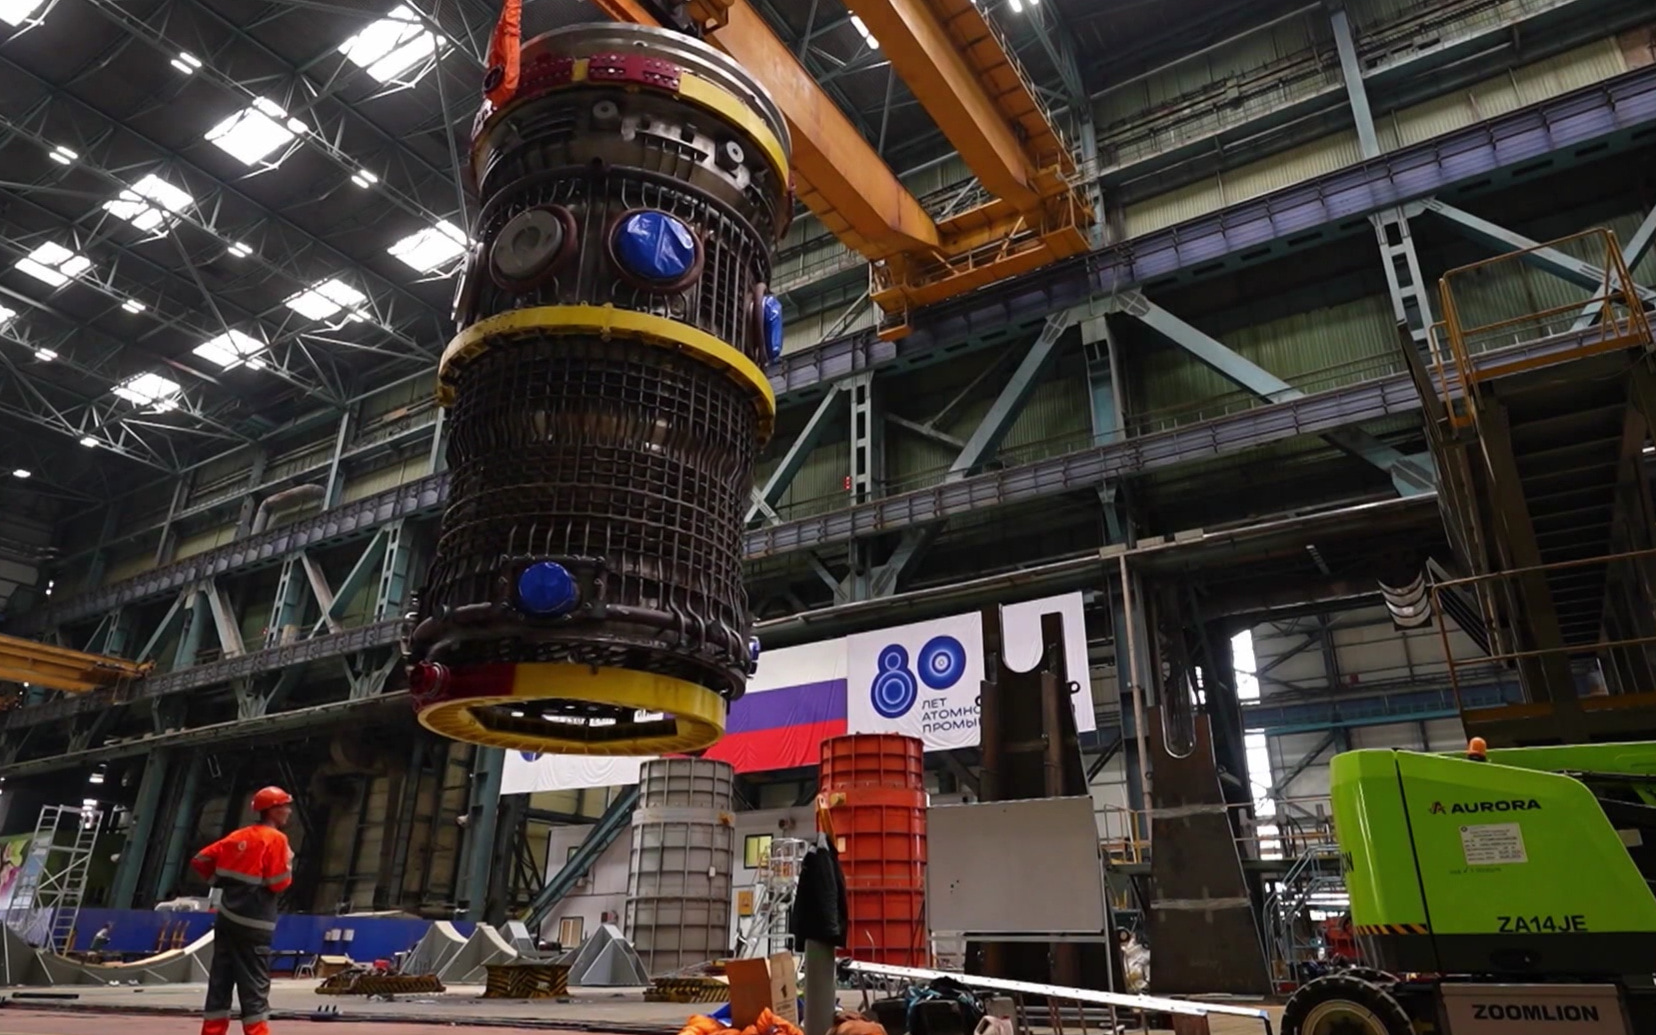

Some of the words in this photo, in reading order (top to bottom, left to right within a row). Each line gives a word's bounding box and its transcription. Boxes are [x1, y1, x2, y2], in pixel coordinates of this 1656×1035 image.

[870, 635, 966, 719] 80
[922, 698, 947, 710] ЛЕТ
[922, 706, 981, 721] АТОМНО
[922, 718, 981, 733] ПРОМЫ
[1451, 799, 1542, 814] AURORA
[1497, 915, 1588, 933] ZA14JE
[1472, 1004, 1600, 1022] ZOOMLION
